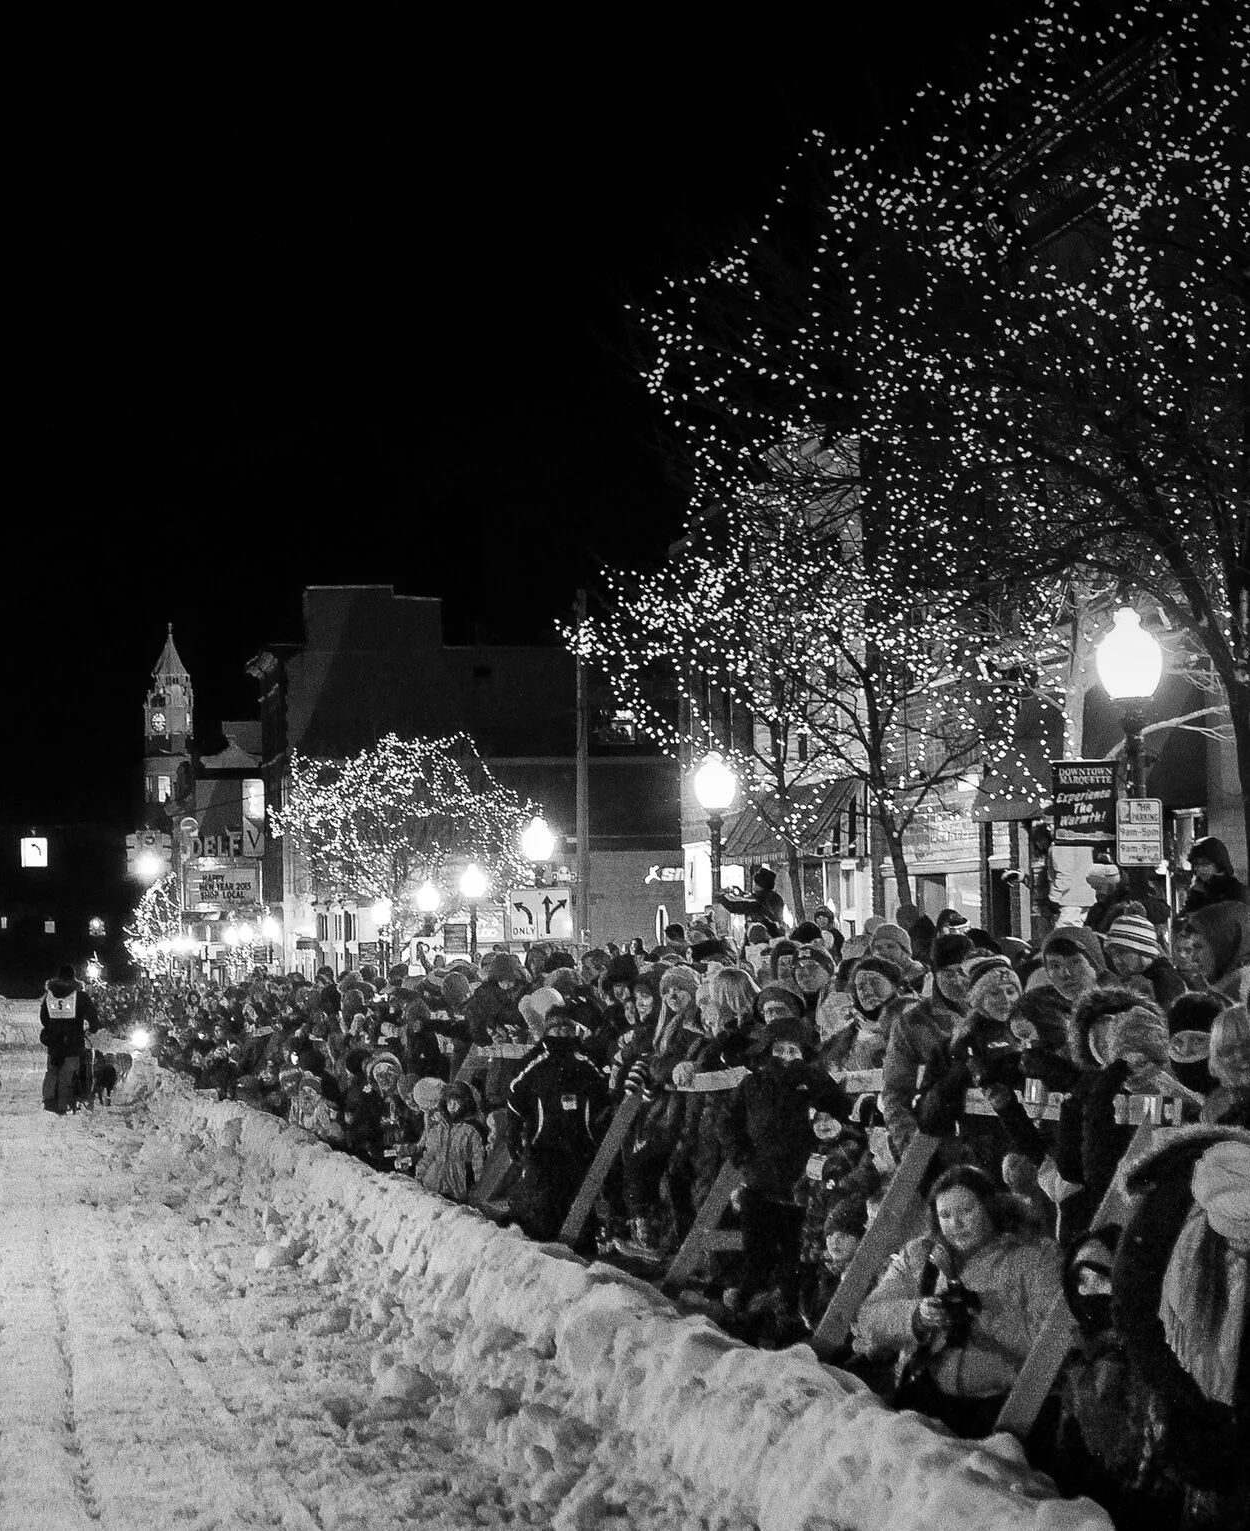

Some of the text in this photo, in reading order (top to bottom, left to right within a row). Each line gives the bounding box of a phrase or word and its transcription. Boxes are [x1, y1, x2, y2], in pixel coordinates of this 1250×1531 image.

[1058, 767, 1113, 776] DOWNTOWN
[1059, 776, 1113, 785] MARQUETTE
[1056, 789, 1111, 804] Experience
[1073, 802, 1093, 814] The
[1060, 811, 1106, 826] Warmth!
[1131, 813, 1159, 822] PARKING
[222, 891, 245, 899] LOCAL
[512, 927, 536, 936] ONLY
